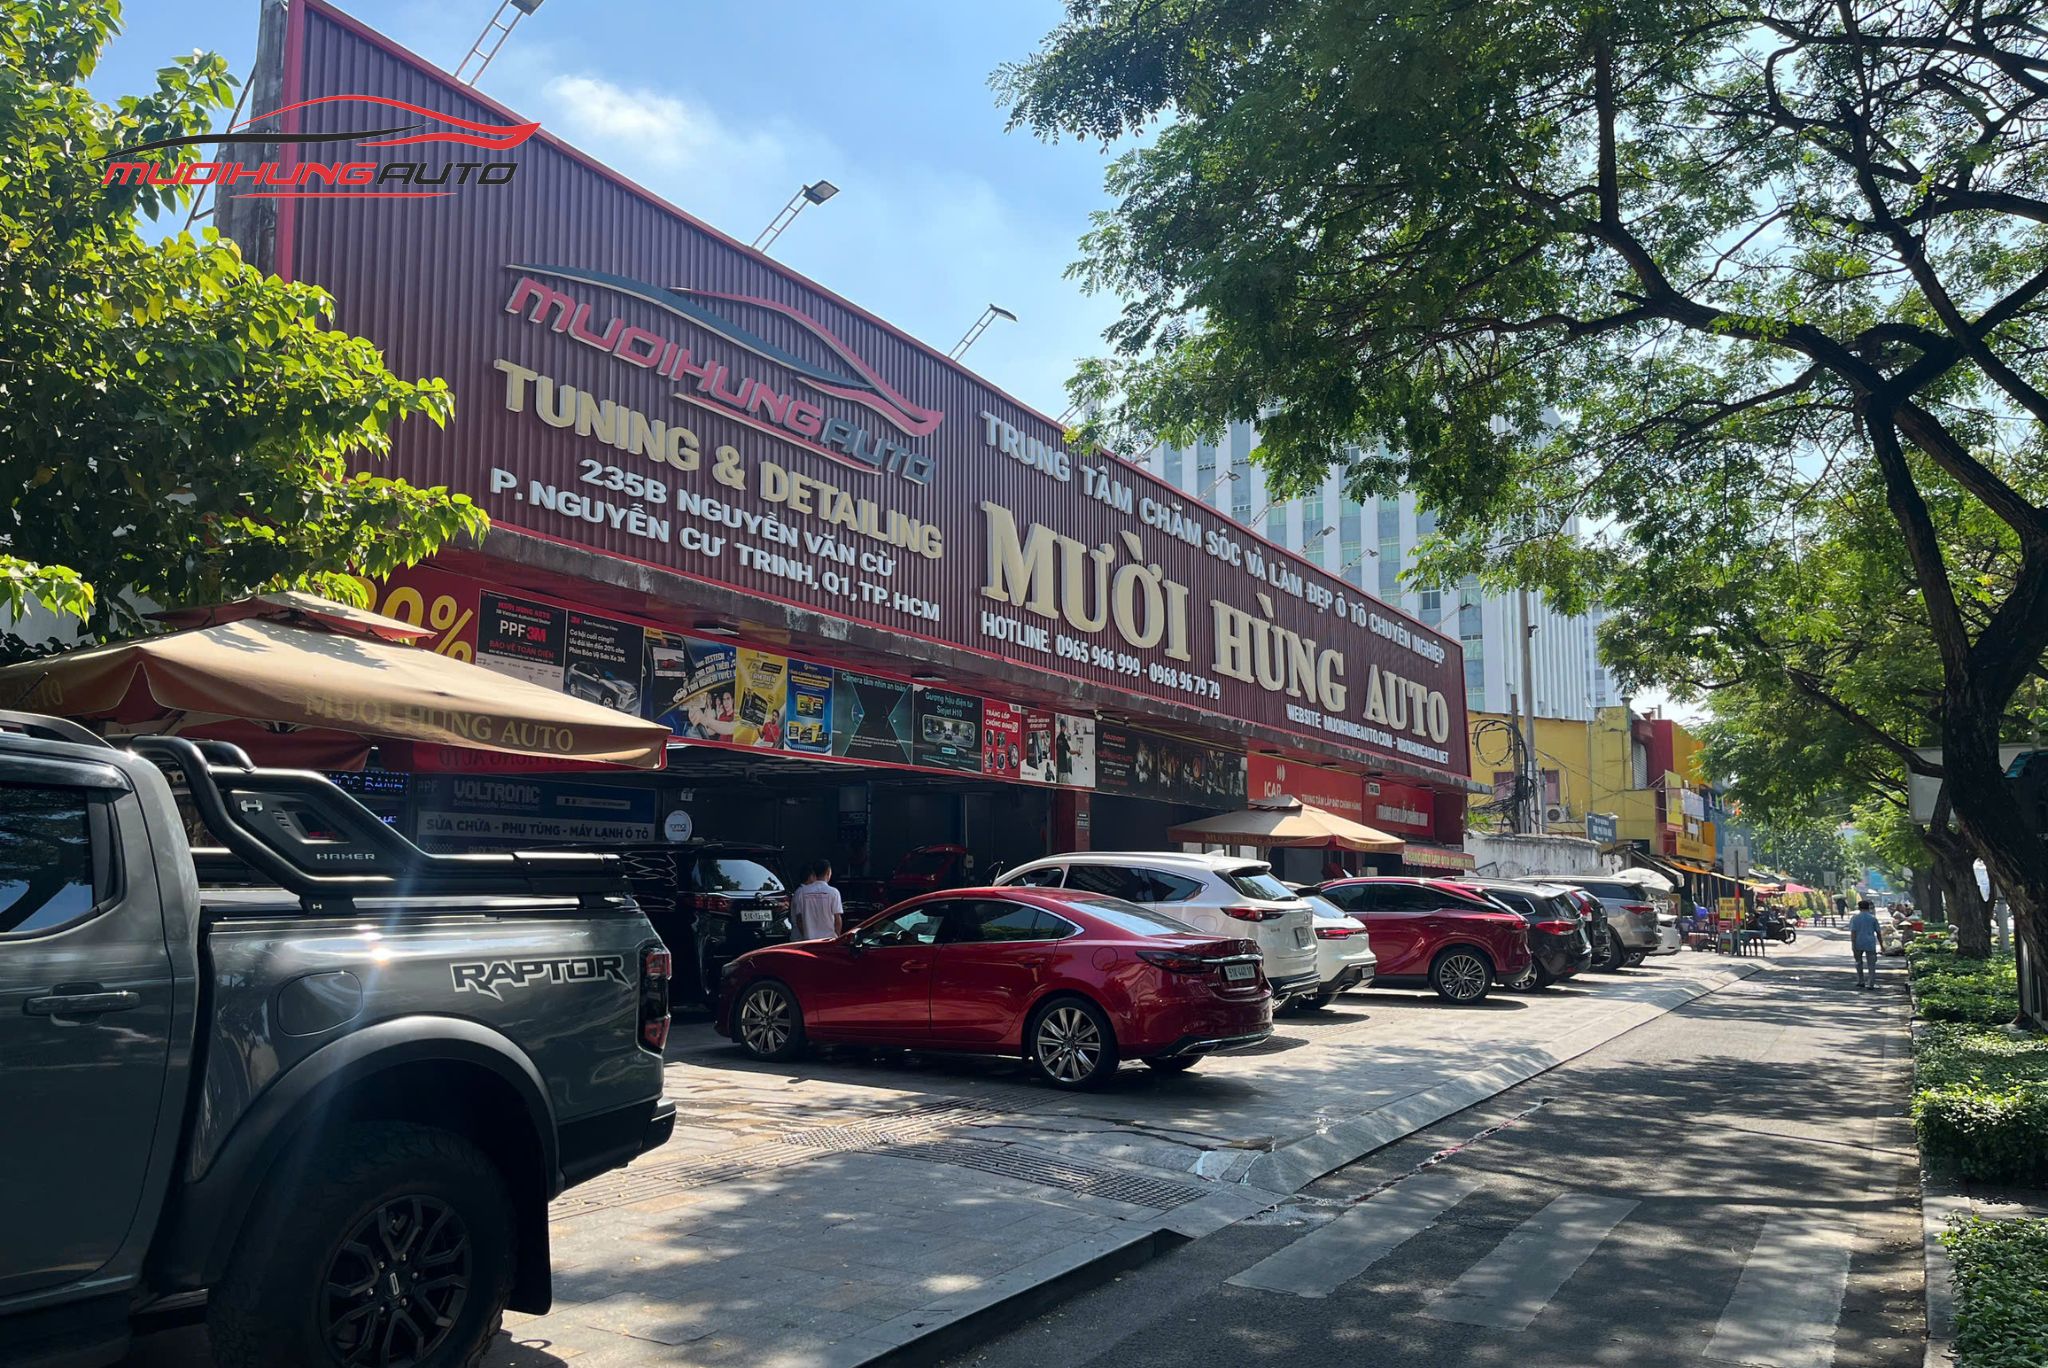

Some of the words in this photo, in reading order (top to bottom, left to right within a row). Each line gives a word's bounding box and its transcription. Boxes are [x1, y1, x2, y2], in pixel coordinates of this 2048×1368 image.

[494, 358, 700, 472] TUNING
[712, 445, 746, 490] &
[760, 461, 943, 559] DETAILING
[529, 480, 669, 543] NGUYỄN
[679, 527, 727, 557] CƯ
[579, 459, 667, 504] 235B
[677, 488, 798, 548] NGUYỄN
[804, 531, 855, 567] VĂN
[860, 549, 897, 577] CỪ
[980, 411, 1071, 482] TRUNG
[1080, 465, 1133, 515] TÂM
[1139, 497, 1202, 548] CHĂM
[1205, 528, 1241, 567] SÓC
[1245, 543, 1266, 581] VÀ
[1269, 561, 1303, 598] LÀM
[1306, 582, 1333, 614] ĐẸP
[1335, 591, 1347, 618] Ô
[1348, 602, 1367, 628] TÔ
[1368, 612, 1411, 649] CHUYÊN
[1411, 634, 1445, 668] NGHIỆP
[500, 620, 526, 637] PPF
[527, 626, 546, 642] 3M
[980, 500, 1191, 662] MƯỜI
[1210, 592, 1347, 713] HÙNG
[1362, 664, 1450, 744] AUTO
[1056, 634, 1089, 664] 0965
[1092, 645, 1114, 671] 966
[1117, 653, 1141, 677] 999
[1149, 662, 1178, 689] 0968
[502, 720, 574, 751] AUTO
[454, 780, 541, 804] VOLTRONIC
[449, 954, 633, 1002] RAPTOR
